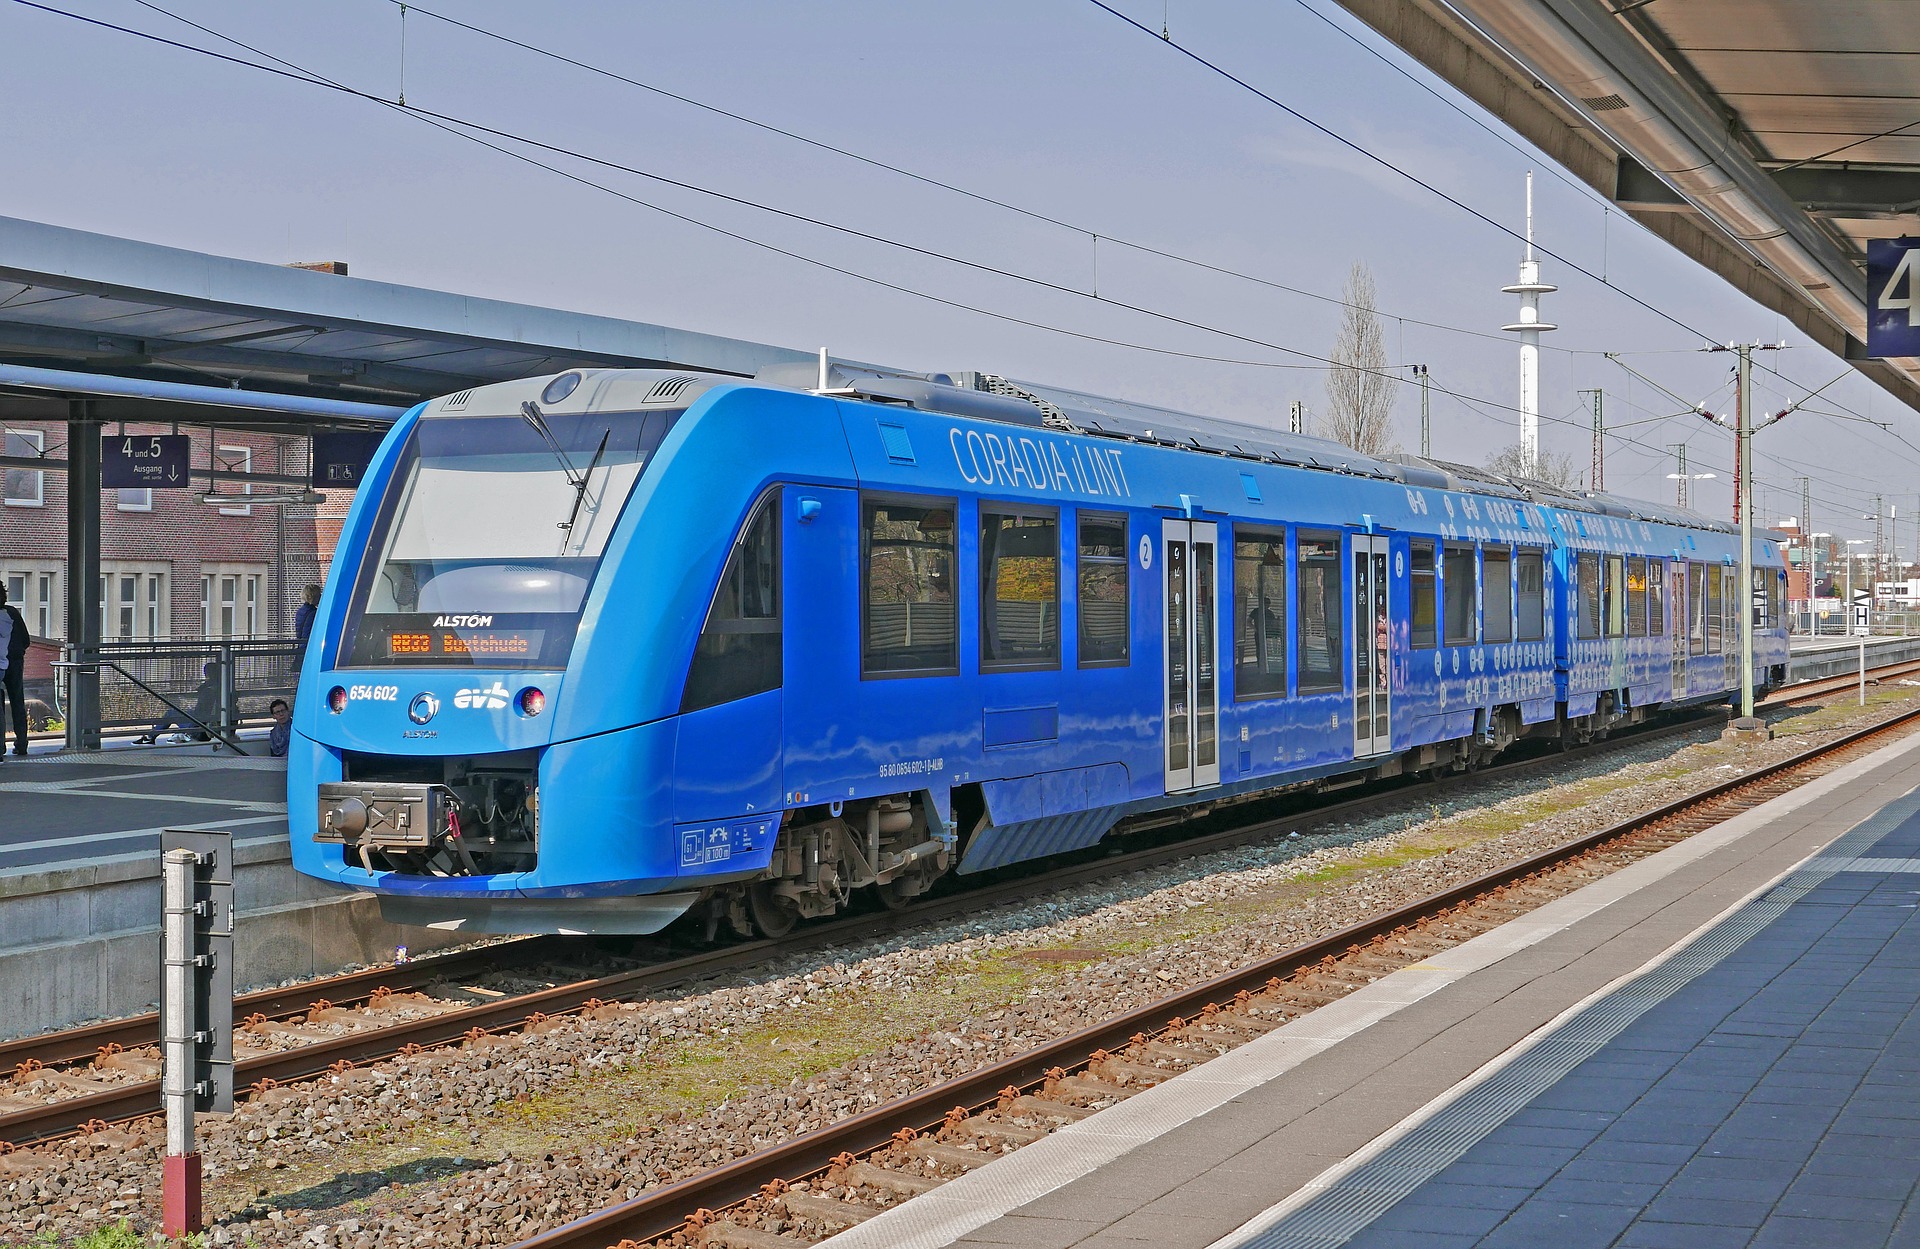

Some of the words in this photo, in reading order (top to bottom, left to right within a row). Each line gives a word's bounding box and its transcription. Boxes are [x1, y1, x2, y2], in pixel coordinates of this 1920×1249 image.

[1878, 248, 1920, 326] 4
[122, 437, 133, 458] 4
[135, 450, 148, 458] und
[150, 437, 161, 458] 5
[950, 427, 1075, 493] CORADIA
[133, 464, 163, 474] Ausgang
[433, 614, 492, 628] ALSTOM
[1856, 608, 1867, 625] H
[444, 635, 528, 652] Buxtehude
[350, 685, 372, 700] 654
[373, 685, 398, 701] 602
[454, 682, 510, 709] evb
[403, 730, 438, 739] ALSTOM
[880, 764, 888, 778] 95
[888, 763, 896, 777] 80
[896, 761, 911, 776] 0654
[712, 848, 722, 859] 100
